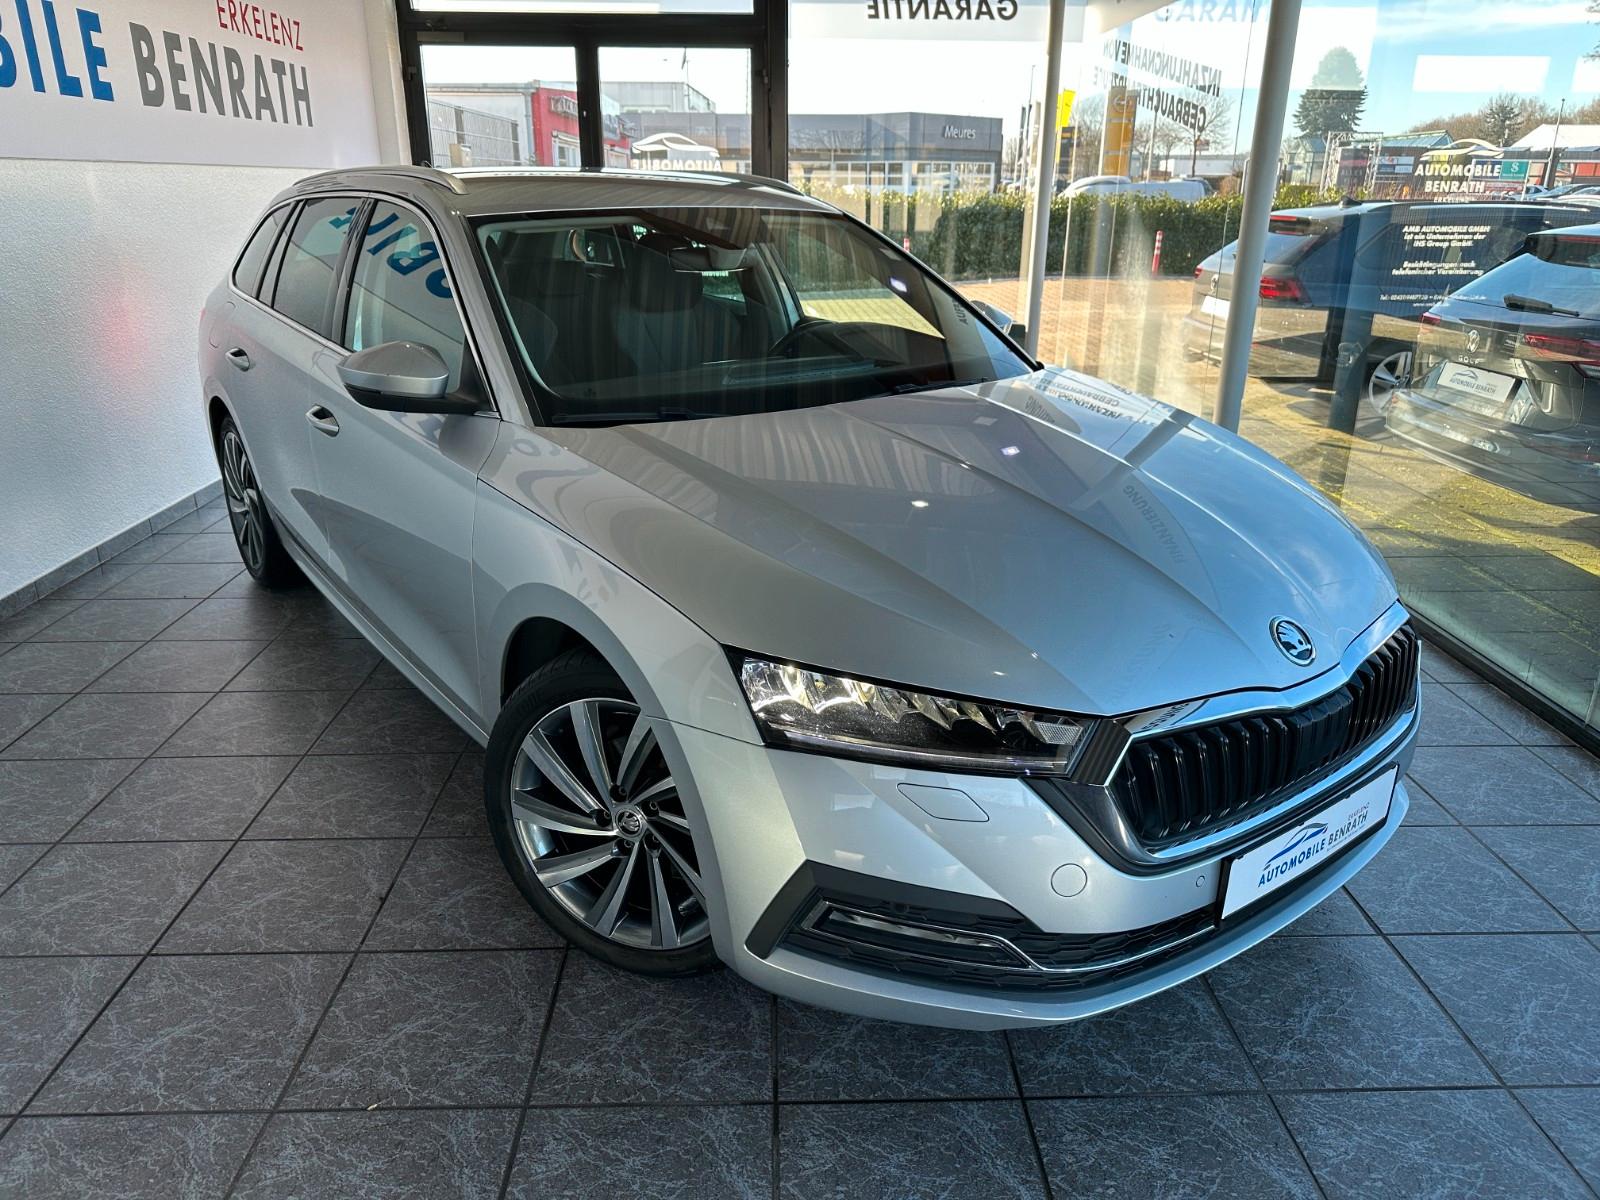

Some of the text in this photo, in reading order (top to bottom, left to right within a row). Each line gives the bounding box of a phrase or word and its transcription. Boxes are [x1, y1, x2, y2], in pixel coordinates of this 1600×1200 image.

[216, 0, 304, 51] ERKELENZ
[129, 21, 314, 128] BENRATH
[944, 125, 976, 139] Meures
[1414, 163, 1501, 177] AUTOMOBILE
[1425, 180, 1486, 193] BENRATH
[1257, 839, 1328, 888] AUTOMOBILE
[1327, 810, 1369, 846] BENRATH
